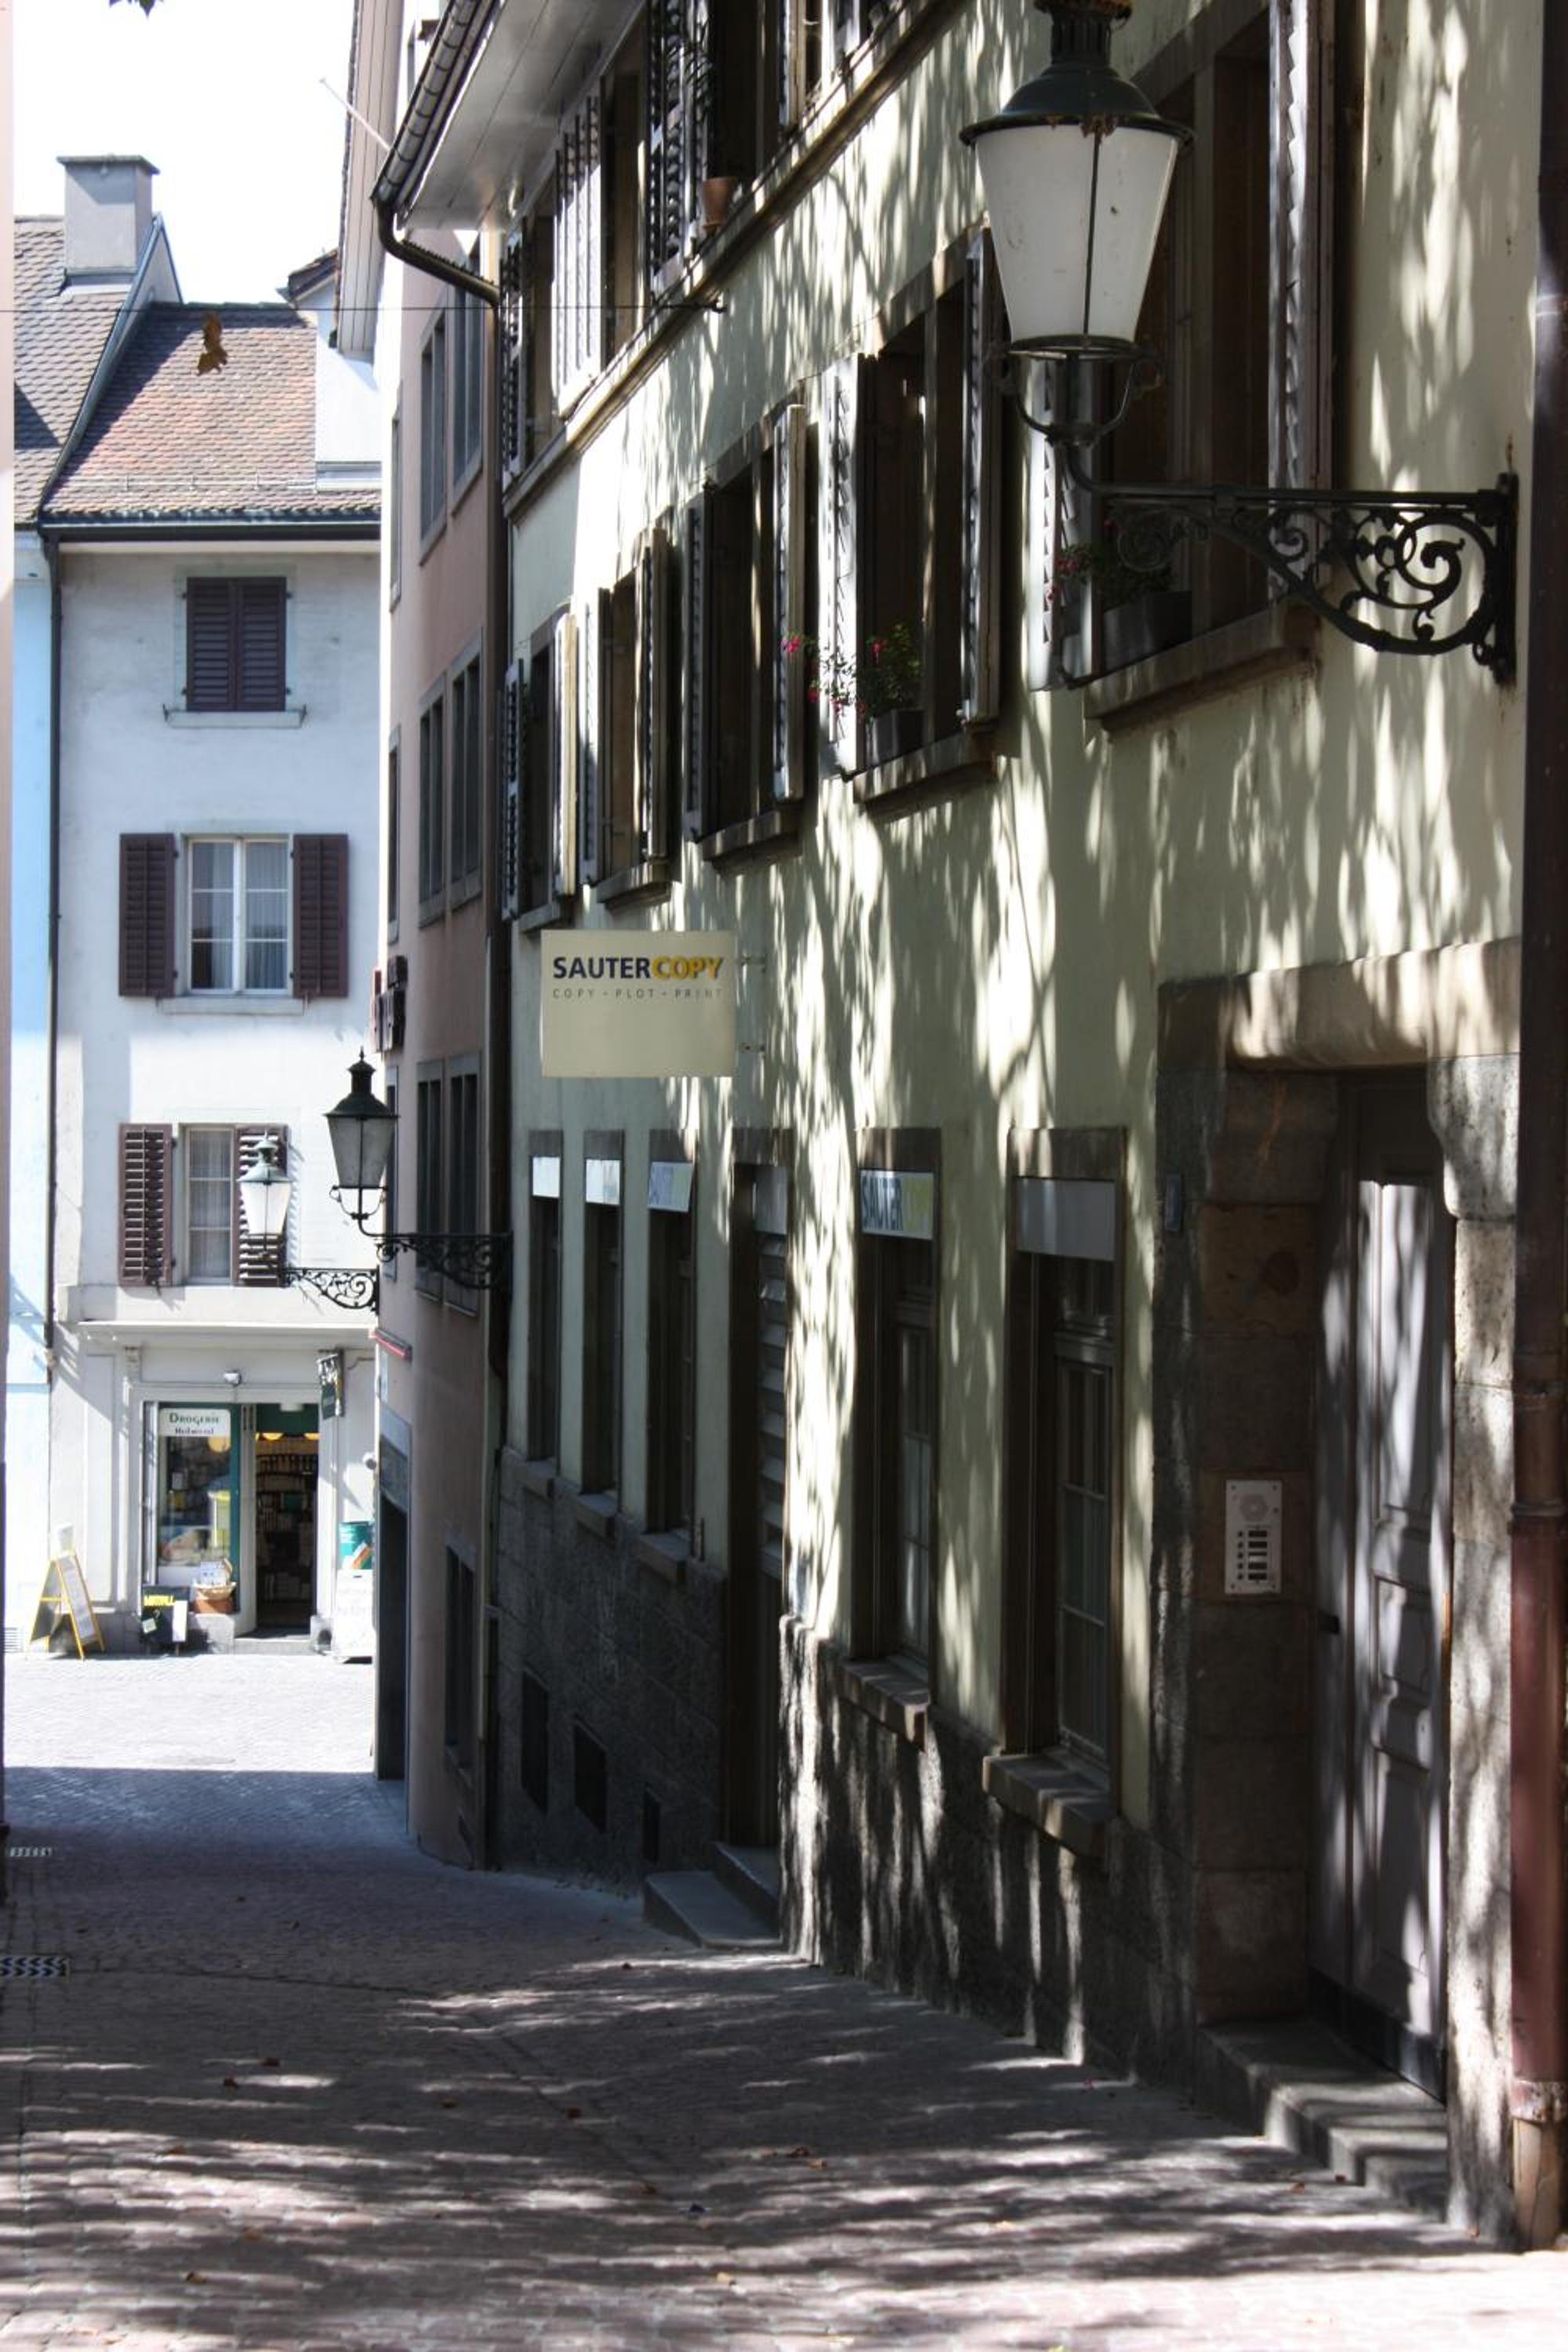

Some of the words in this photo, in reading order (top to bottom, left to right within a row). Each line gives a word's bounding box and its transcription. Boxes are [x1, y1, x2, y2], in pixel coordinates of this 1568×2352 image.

[552, 988, 594, 999] COPY
[615, 988, 655, 999] PLOT
[674, 988, 723, 999] PRINT
